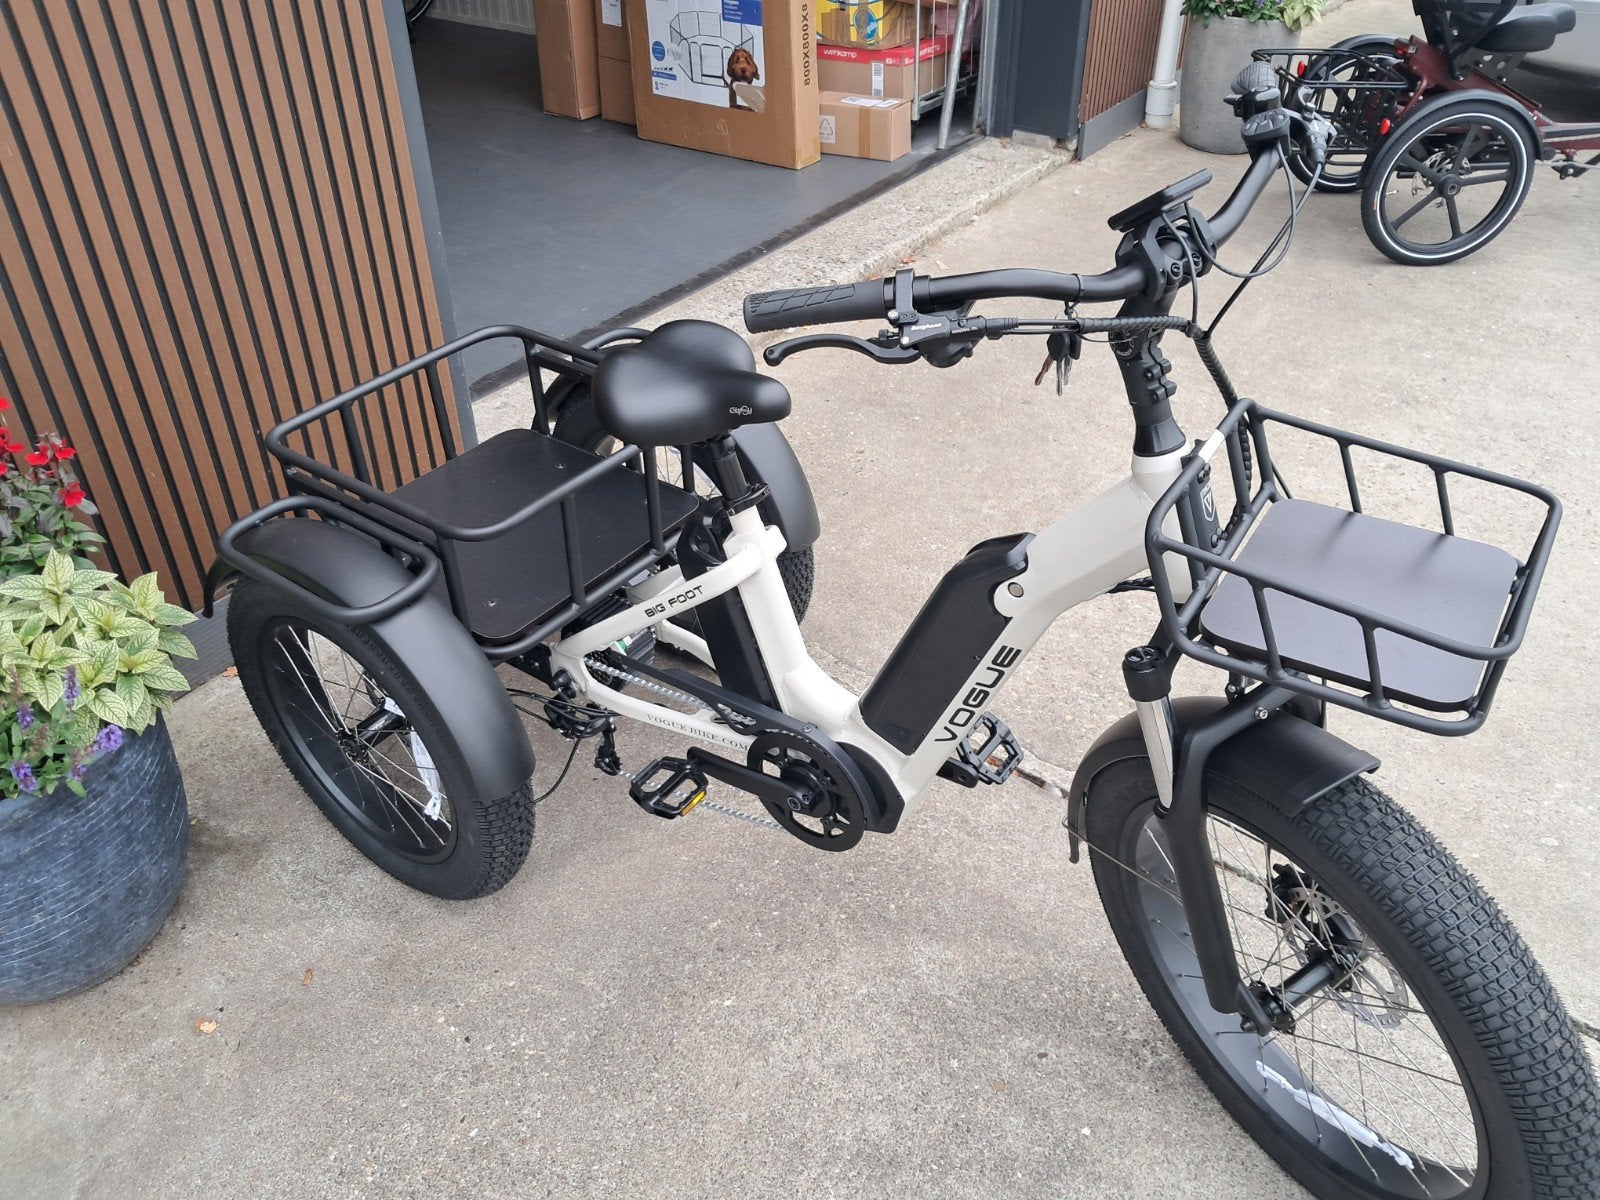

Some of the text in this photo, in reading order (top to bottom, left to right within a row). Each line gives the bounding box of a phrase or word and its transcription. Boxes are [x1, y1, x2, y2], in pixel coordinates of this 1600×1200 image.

[801, 0, 811, 86] 800X800X8
[823, 48, 857, 58] wehkamp
[644, 584, 703, 617] BIG FOOT
[934, 645, 1022, 742] VOGUE
[646, 714, 687, 731] VOGUE
